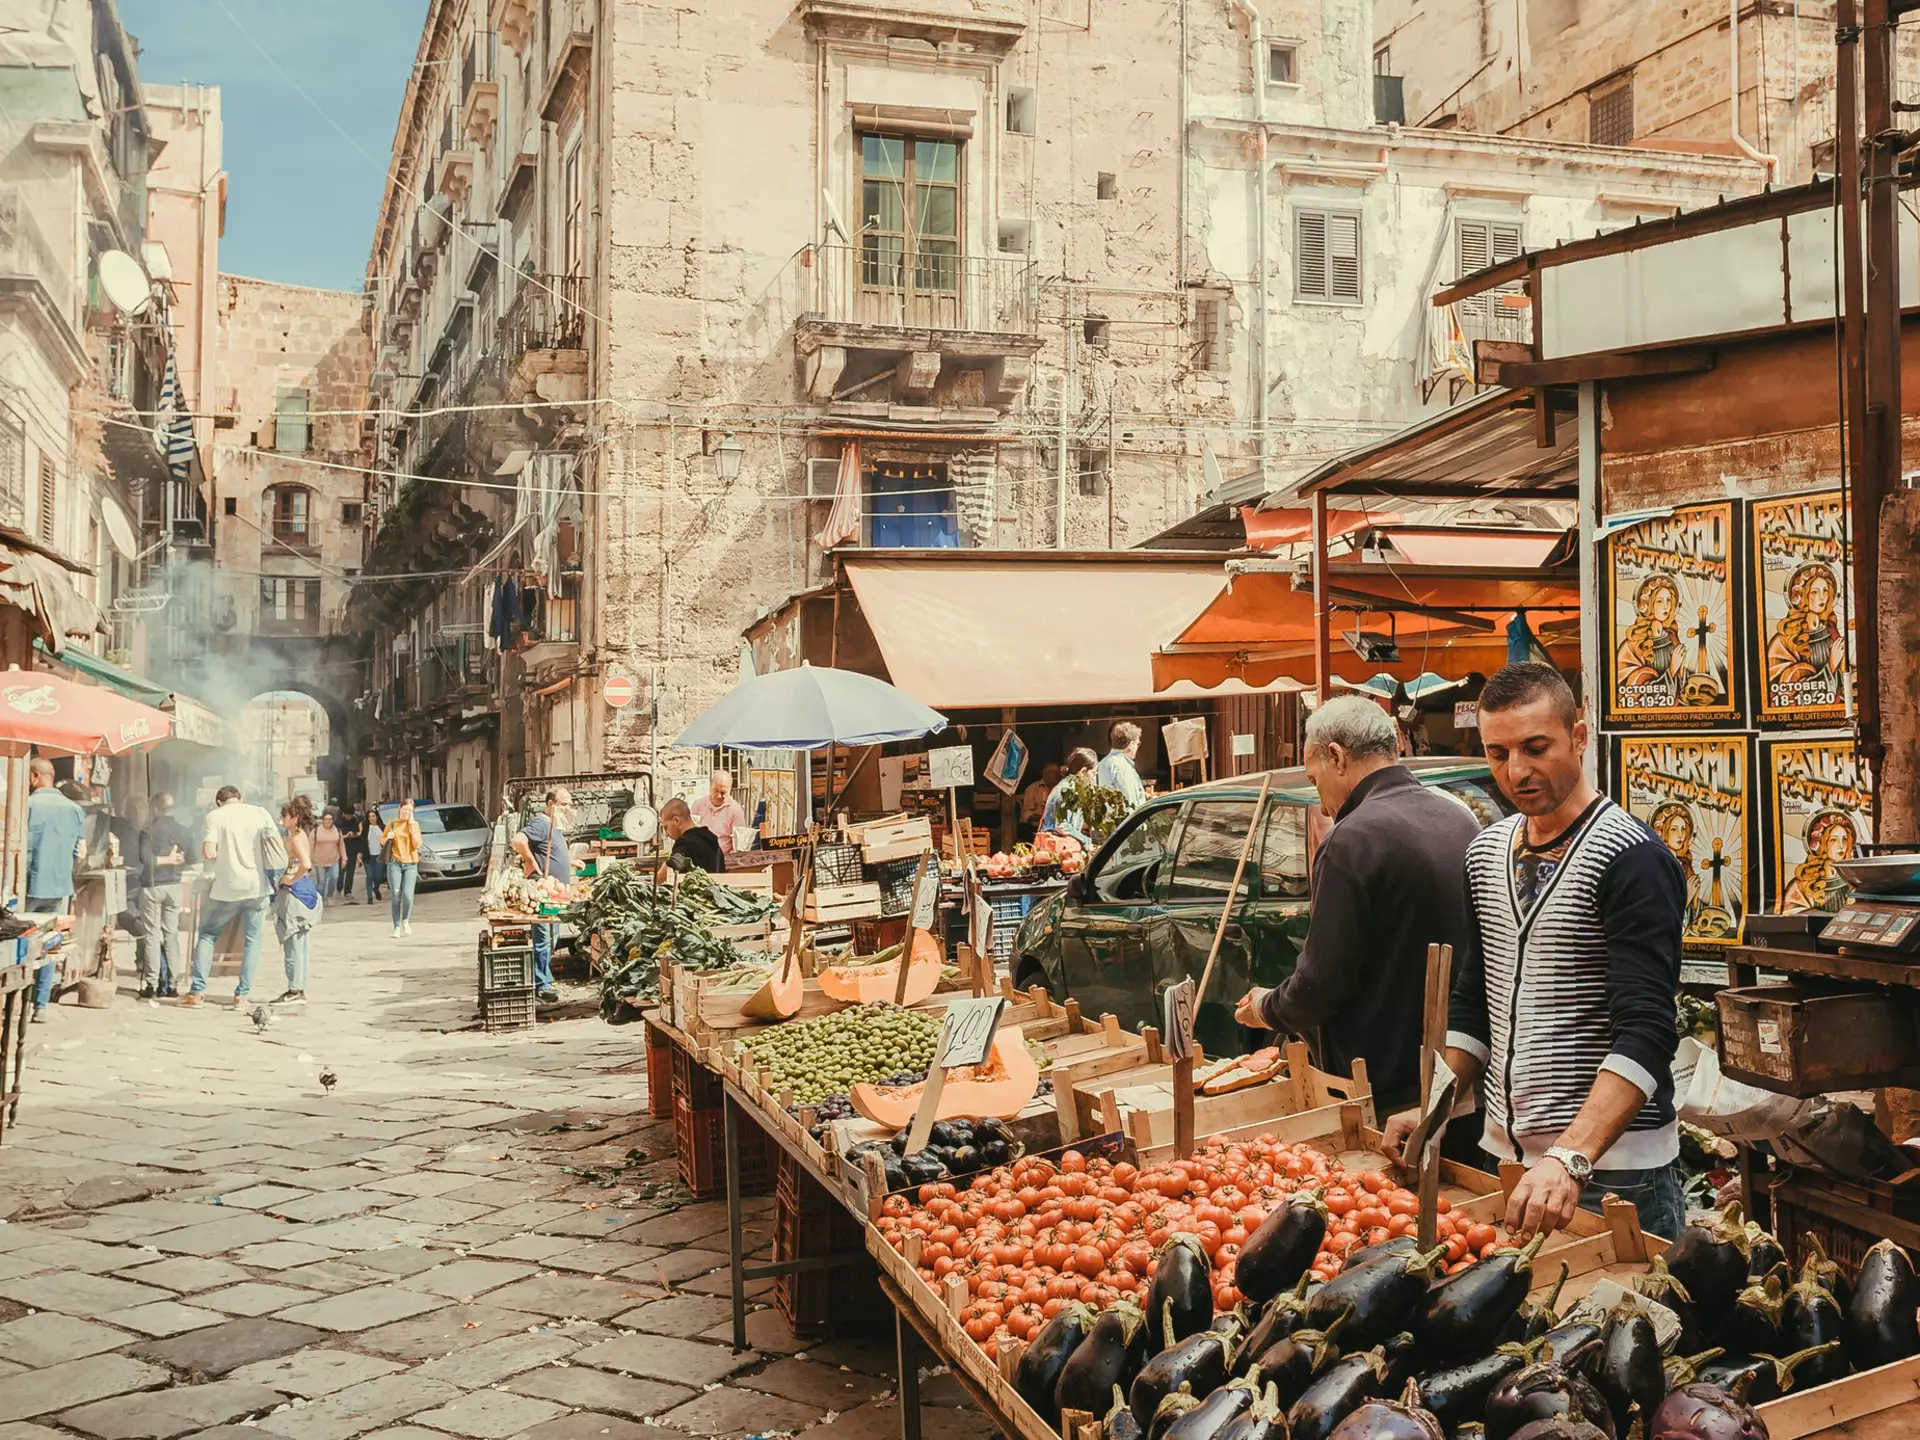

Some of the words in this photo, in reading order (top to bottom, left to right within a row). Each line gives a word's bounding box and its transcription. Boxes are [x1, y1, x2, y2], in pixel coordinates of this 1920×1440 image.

[1759, 501, 1852, 547] PALER
[1614, 508, 1726, 563] ALERMO
[1618, 684, 1668, 695] OCTOBER
[1770, 680, 1827, 692] OCTOBER
[1619, 695, 1675, 708] 18-19-20
[1772, 692, 1836, 707] 18-19-20
[1624, 714, 1636, 722] DEL
[1638, 713, 1689, 721] MEDITERRANEO
[1690, 712, 1731, 720] PADIGLIONE
[1732, 712, 1741, 720] 20
[1756, 715, 1777, 723] FIERA
[1778, 714, 1792, 722] DEL
[1794, 711, 1846, 721] MEDITERRANE
[1627, 742, 1741, 795] PALERMO
